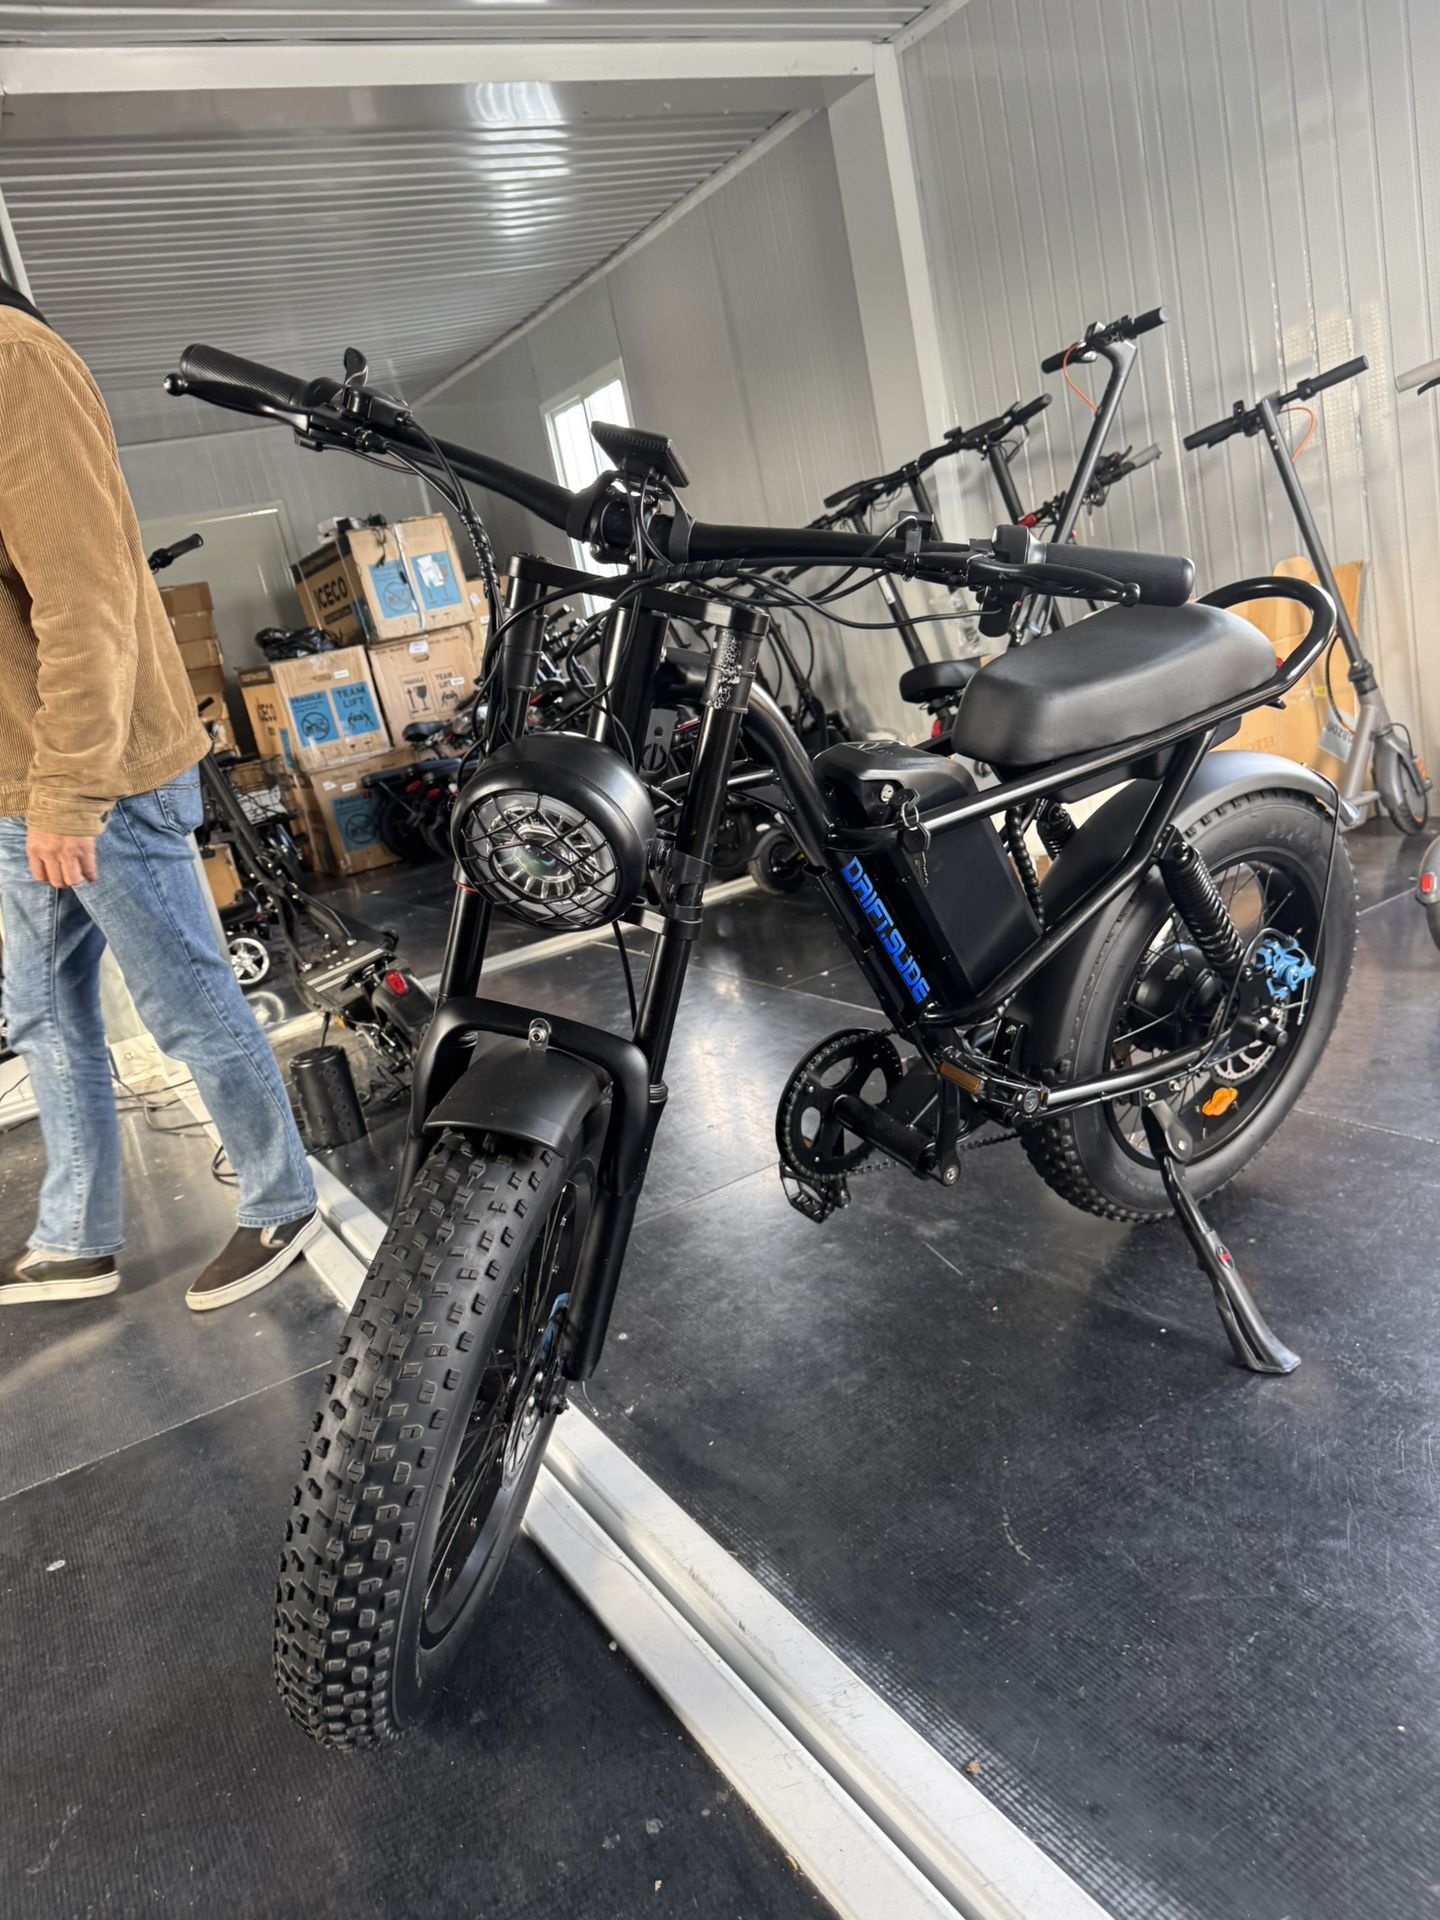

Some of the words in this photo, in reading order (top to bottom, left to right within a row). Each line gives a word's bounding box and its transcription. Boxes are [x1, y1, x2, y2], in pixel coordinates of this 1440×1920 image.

[313, 576, 348, 611] ICECO
[337, 686, 365, 699] TEAM
[343, 697, 364, 708] LIFT
